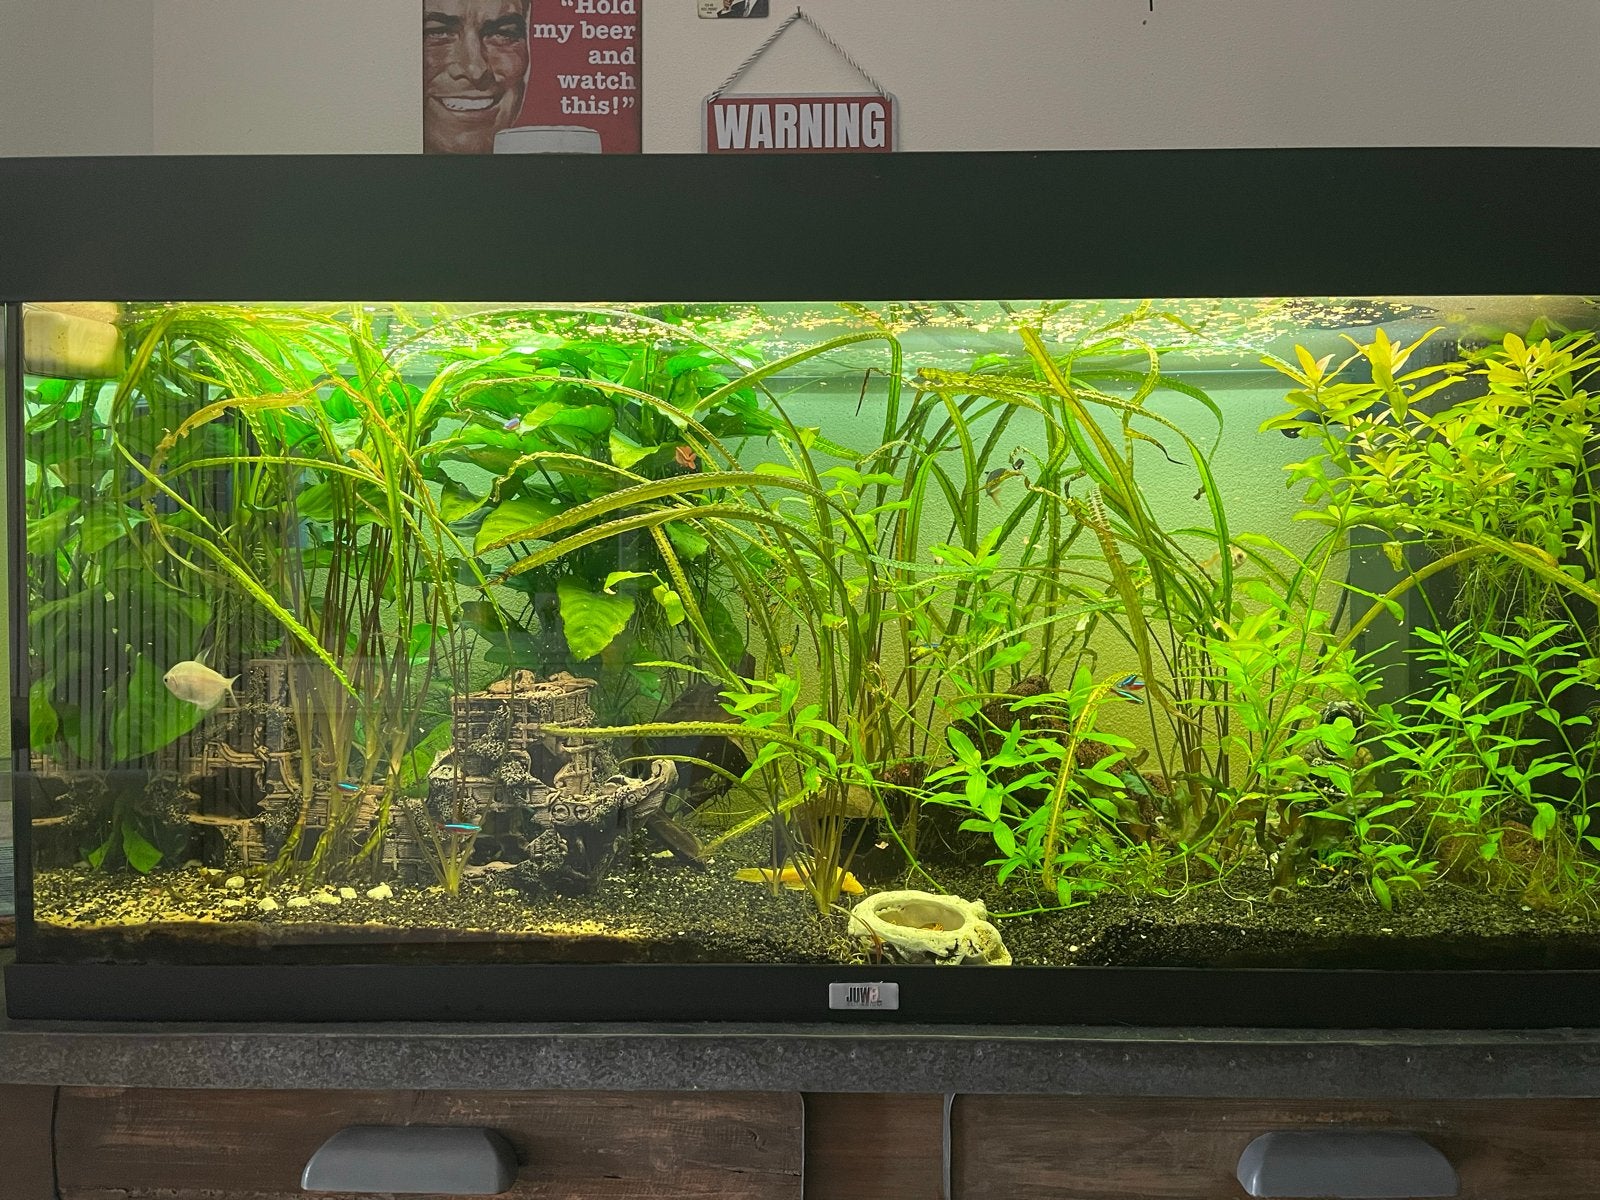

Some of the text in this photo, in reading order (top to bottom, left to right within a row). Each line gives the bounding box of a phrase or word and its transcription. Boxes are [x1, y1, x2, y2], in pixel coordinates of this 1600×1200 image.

[533, 21, 636, 43] my beer
[588, 47, 636, 65] and
[557, 72, 636, 90] watch
[560, 95, 635, 115] this!”
[714, 102, 886, 149] WARNING
